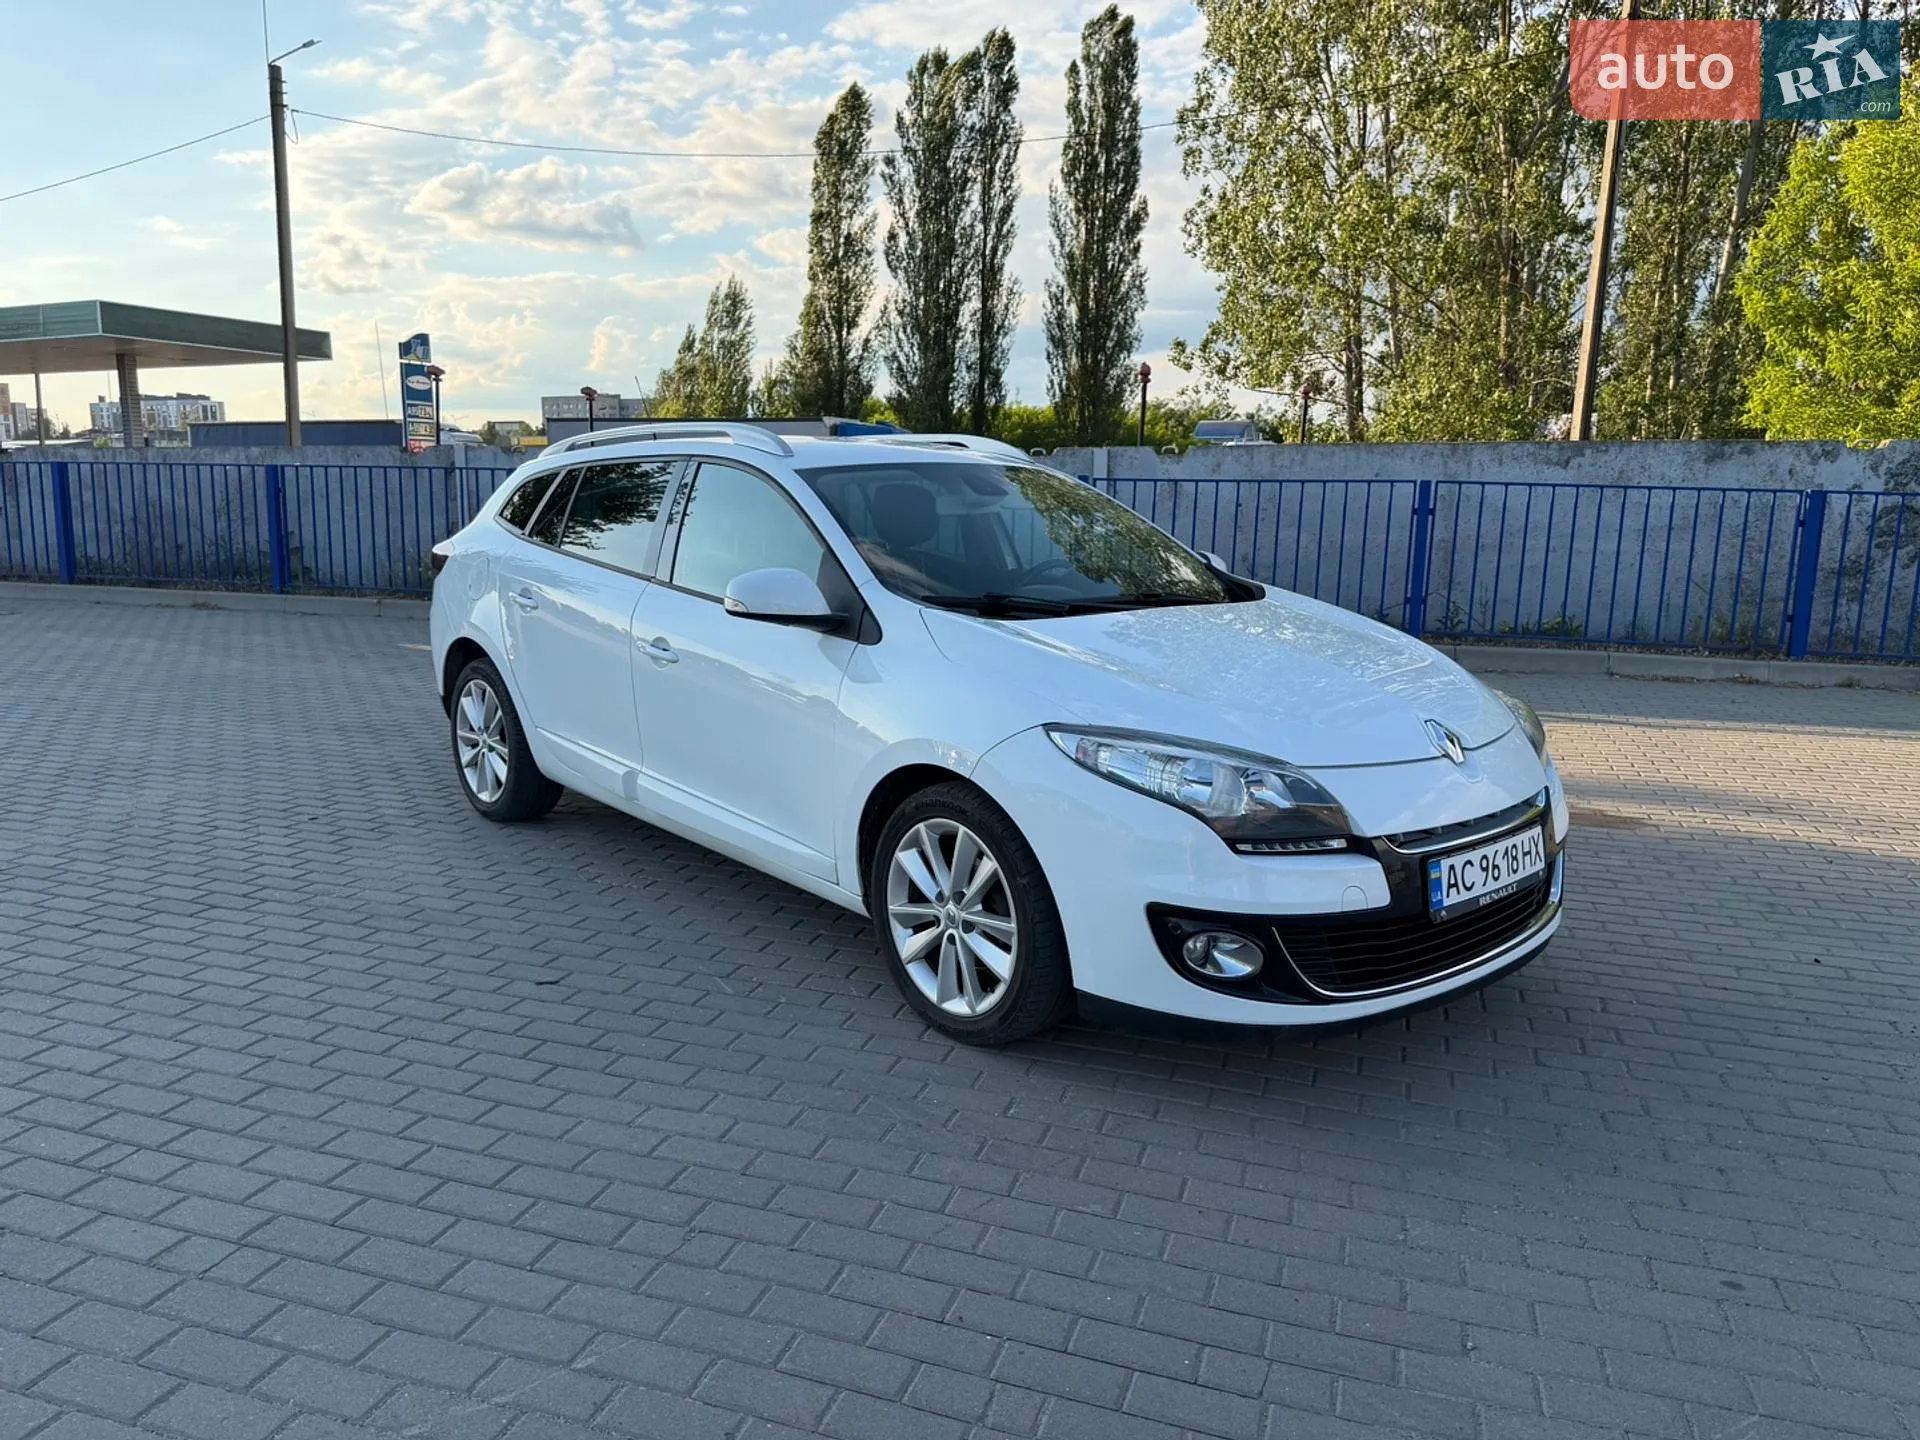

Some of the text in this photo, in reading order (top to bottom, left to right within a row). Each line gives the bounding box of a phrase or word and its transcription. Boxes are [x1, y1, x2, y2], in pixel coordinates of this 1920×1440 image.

[1446, 831, 1543, 898] AC 9618 HX
